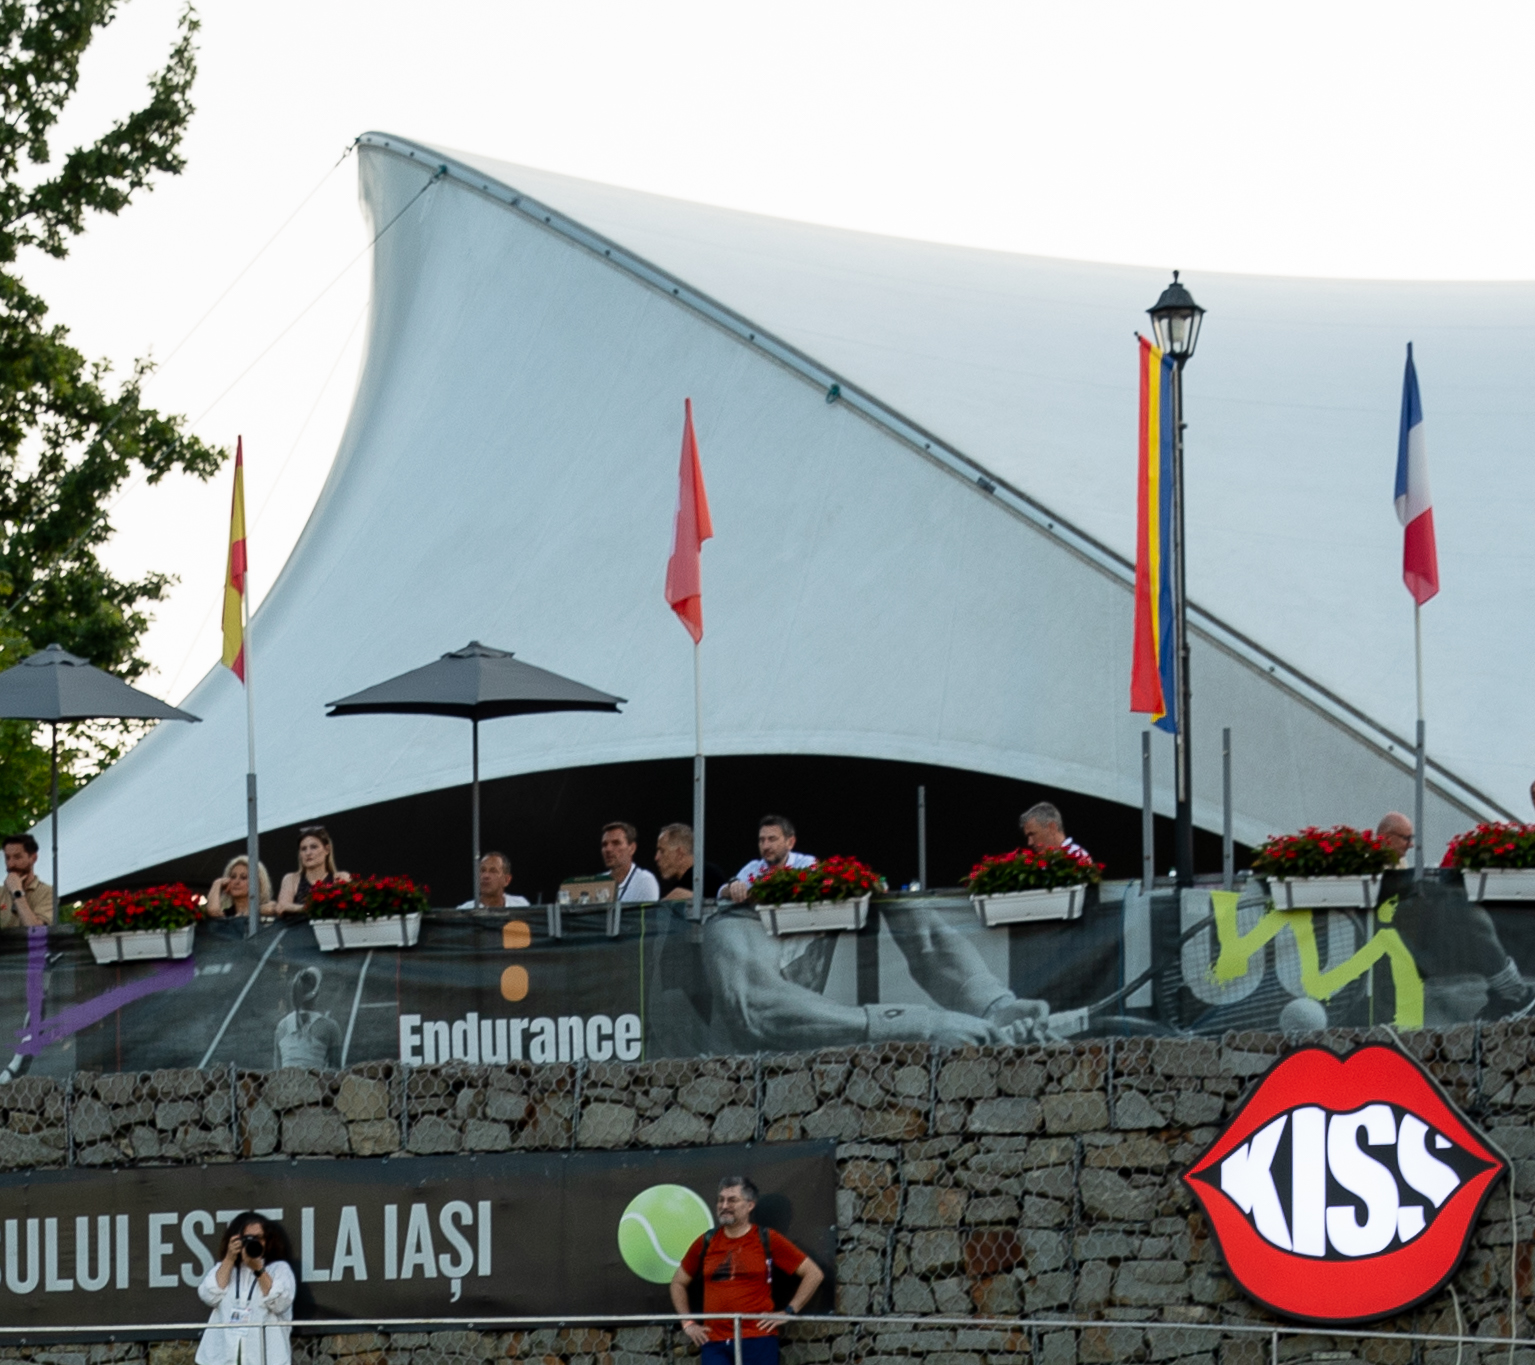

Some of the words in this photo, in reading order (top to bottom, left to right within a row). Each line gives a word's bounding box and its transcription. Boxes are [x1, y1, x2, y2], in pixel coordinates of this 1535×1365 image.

[399, 1013, 642, 1065] Endurance
[1221, 1104, 1461, 1258] KISS
[302, 1205, 368, 1282] LA
[384, 1200, 492, 1302] IAȘI
